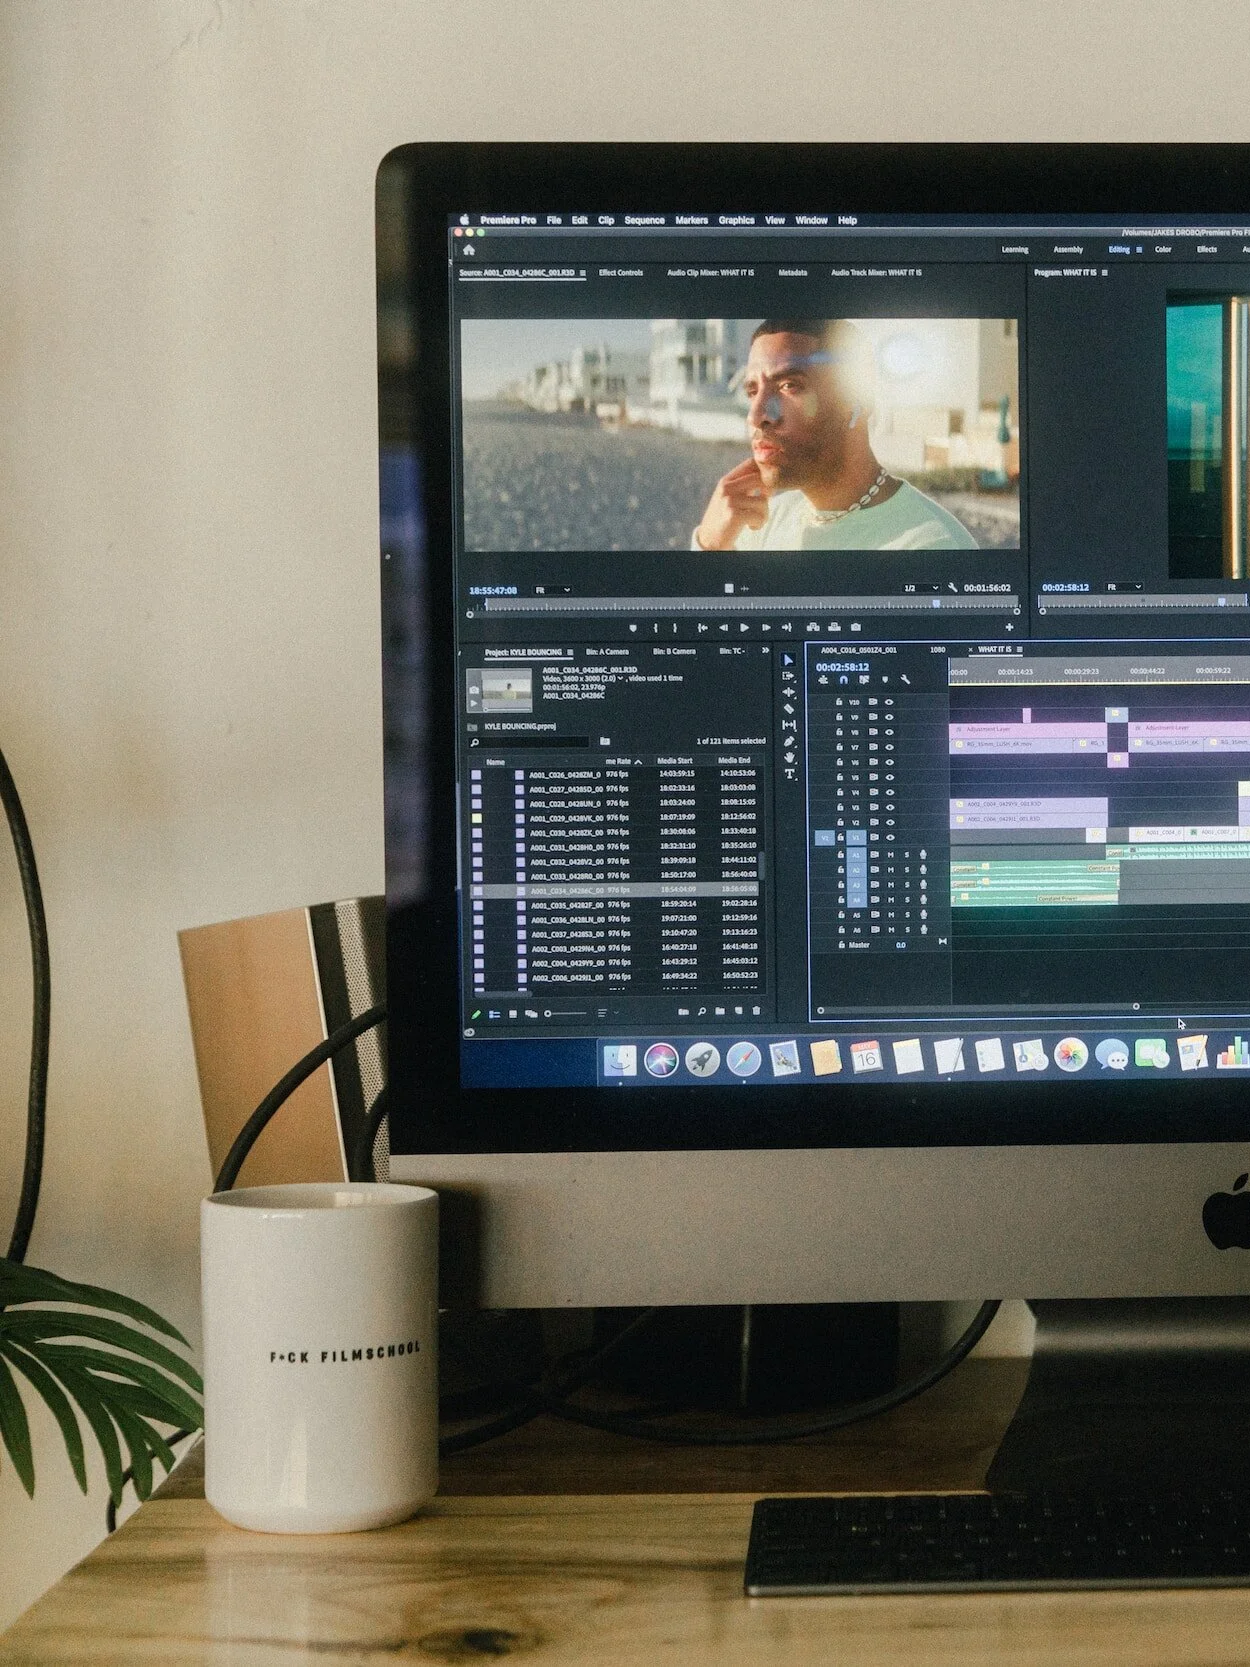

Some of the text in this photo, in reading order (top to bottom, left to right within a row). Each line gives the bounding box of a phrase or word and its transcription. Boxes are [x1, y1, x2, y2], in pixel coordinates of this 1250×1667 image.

[480, 215, 858, 227] Premiere Pro File Edit Clip Sequence Markers Graphics View Window Help
[1001, 245, 1028, 255] Learning
[1054, 245, 1083, 255] Assembly
[1109, 245, 1131, 255] Editing
[1154, 245, 1172, 253] Color
[1197, 245, 1217, 254] Effects
[459, 269, 482, 277] Source:
[598, 268, 644, 277] Effect Controls
[667, 268, 686, 277] Audio
[687, 268, 699, 278] Clip
[700, 269, 719, 277] Mixer:
[720, 268, 740, 277] WHAT
[778, 268, 809, 277] Metadata
[831, 268, 850, 277] Audio
[850, 268, 867, 277] Track
[868, 268, 887, 277] Mixer:
[888, 268, 908, 277] WHAT
[1033, 268, 1062, 279] Program:
[1063, 268, 1082, 277] WHAT
[469, 586, 545, 595] 18:55:47:08 Fit
[904, 583, 1012, 593] 1/2 00:01:56:02
[1041, 583, 1117, 592] 00:02:58:12 Fit
[484, 648, 563, 658] Project: KYLE BOUNCING
[585, 648, 598, 656] Bin:
[605, 647, 630, 656] Camera
[652, 647, 665, 656] Bin:
[672, 647, 697, 655] Camera
[719, 647, 732, 655] Bin:
[930, 645, 947, 654] 1080
[977, 645, 997, 653] WHAT
[815, 662, 870, 672] 00:02:58:12
[542, 675, 562, 683] Video,
[563, 675, 579, 683] 3600
[585, 675, 600, 683] 3000
[601, 674, 617, 683] (2.0)
[647, 674, 662, 682] used
[668, 674, 684, 682] time
[542, 683, 607, 692] 00:01:56:02, 23.976p
[484, 722, 557, 731] KYLE BOUNCING.prproj
[710, 737, 721, 745] 121
[723, 737, 740, 745] items
[740, 737, 767, 745] selected
[485, 758, 506, 766] Name
[617, 757, 632, 765] Rate
[657, 757, 693, 765] Media Start
[717, 756, 751, 765] Media End
[606, 828, 619, 836] 976
[620, 827, 630, 837] fps
[660, 827, 697, 836] 18:30:08:06
[721, 827, 757, 835] 18:33:40:18
[606, 857, 619, 865] 976
[620, 856, 631, 866] fps
[660, 856, 697, 865] 18:39:09:18
[721, 856, 757, 864] 18:44:11:02
[607, 900, 620, 909] 976
[620, 900, 631, 910] fps
[661, 899, 697, 908] 18:59:20:14
[721, 899, 758, 907] 19:02:28:16
[848, 941, 907, 949] Master 0.0
[607, 958, 620, 966] 976
[621, 957, 632, 967] fps
[661, 957, 698, 966] 16:43:29:12
[722, 957, 759, 965] 16:45:03:12
[859, 1052, 876, 1067] 16
[321, 1340, 420, 1363] FILMSCHOOL
